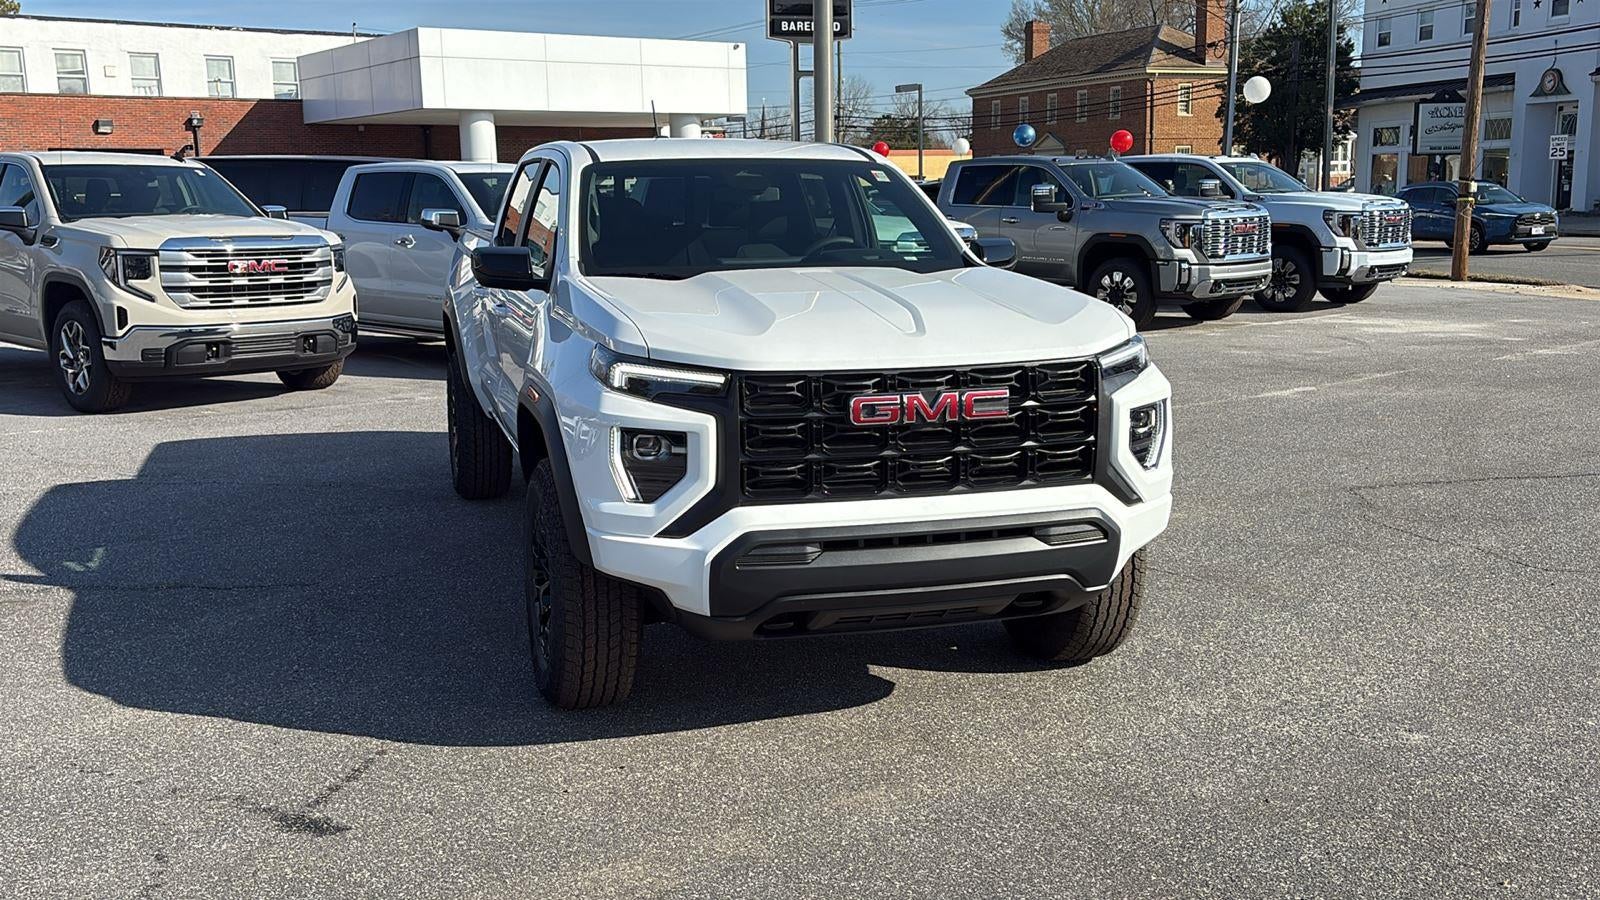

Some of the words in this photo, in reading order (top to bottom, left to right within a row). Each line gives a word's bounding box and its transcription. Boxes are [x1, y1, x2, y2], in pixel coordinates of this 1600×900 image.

[781, 21, 841, 31] BARED
[1550, 147, 1566, 157] 25
[228, 259, 289, 274] GMC
[850, 389, 1010, 425] GMC
